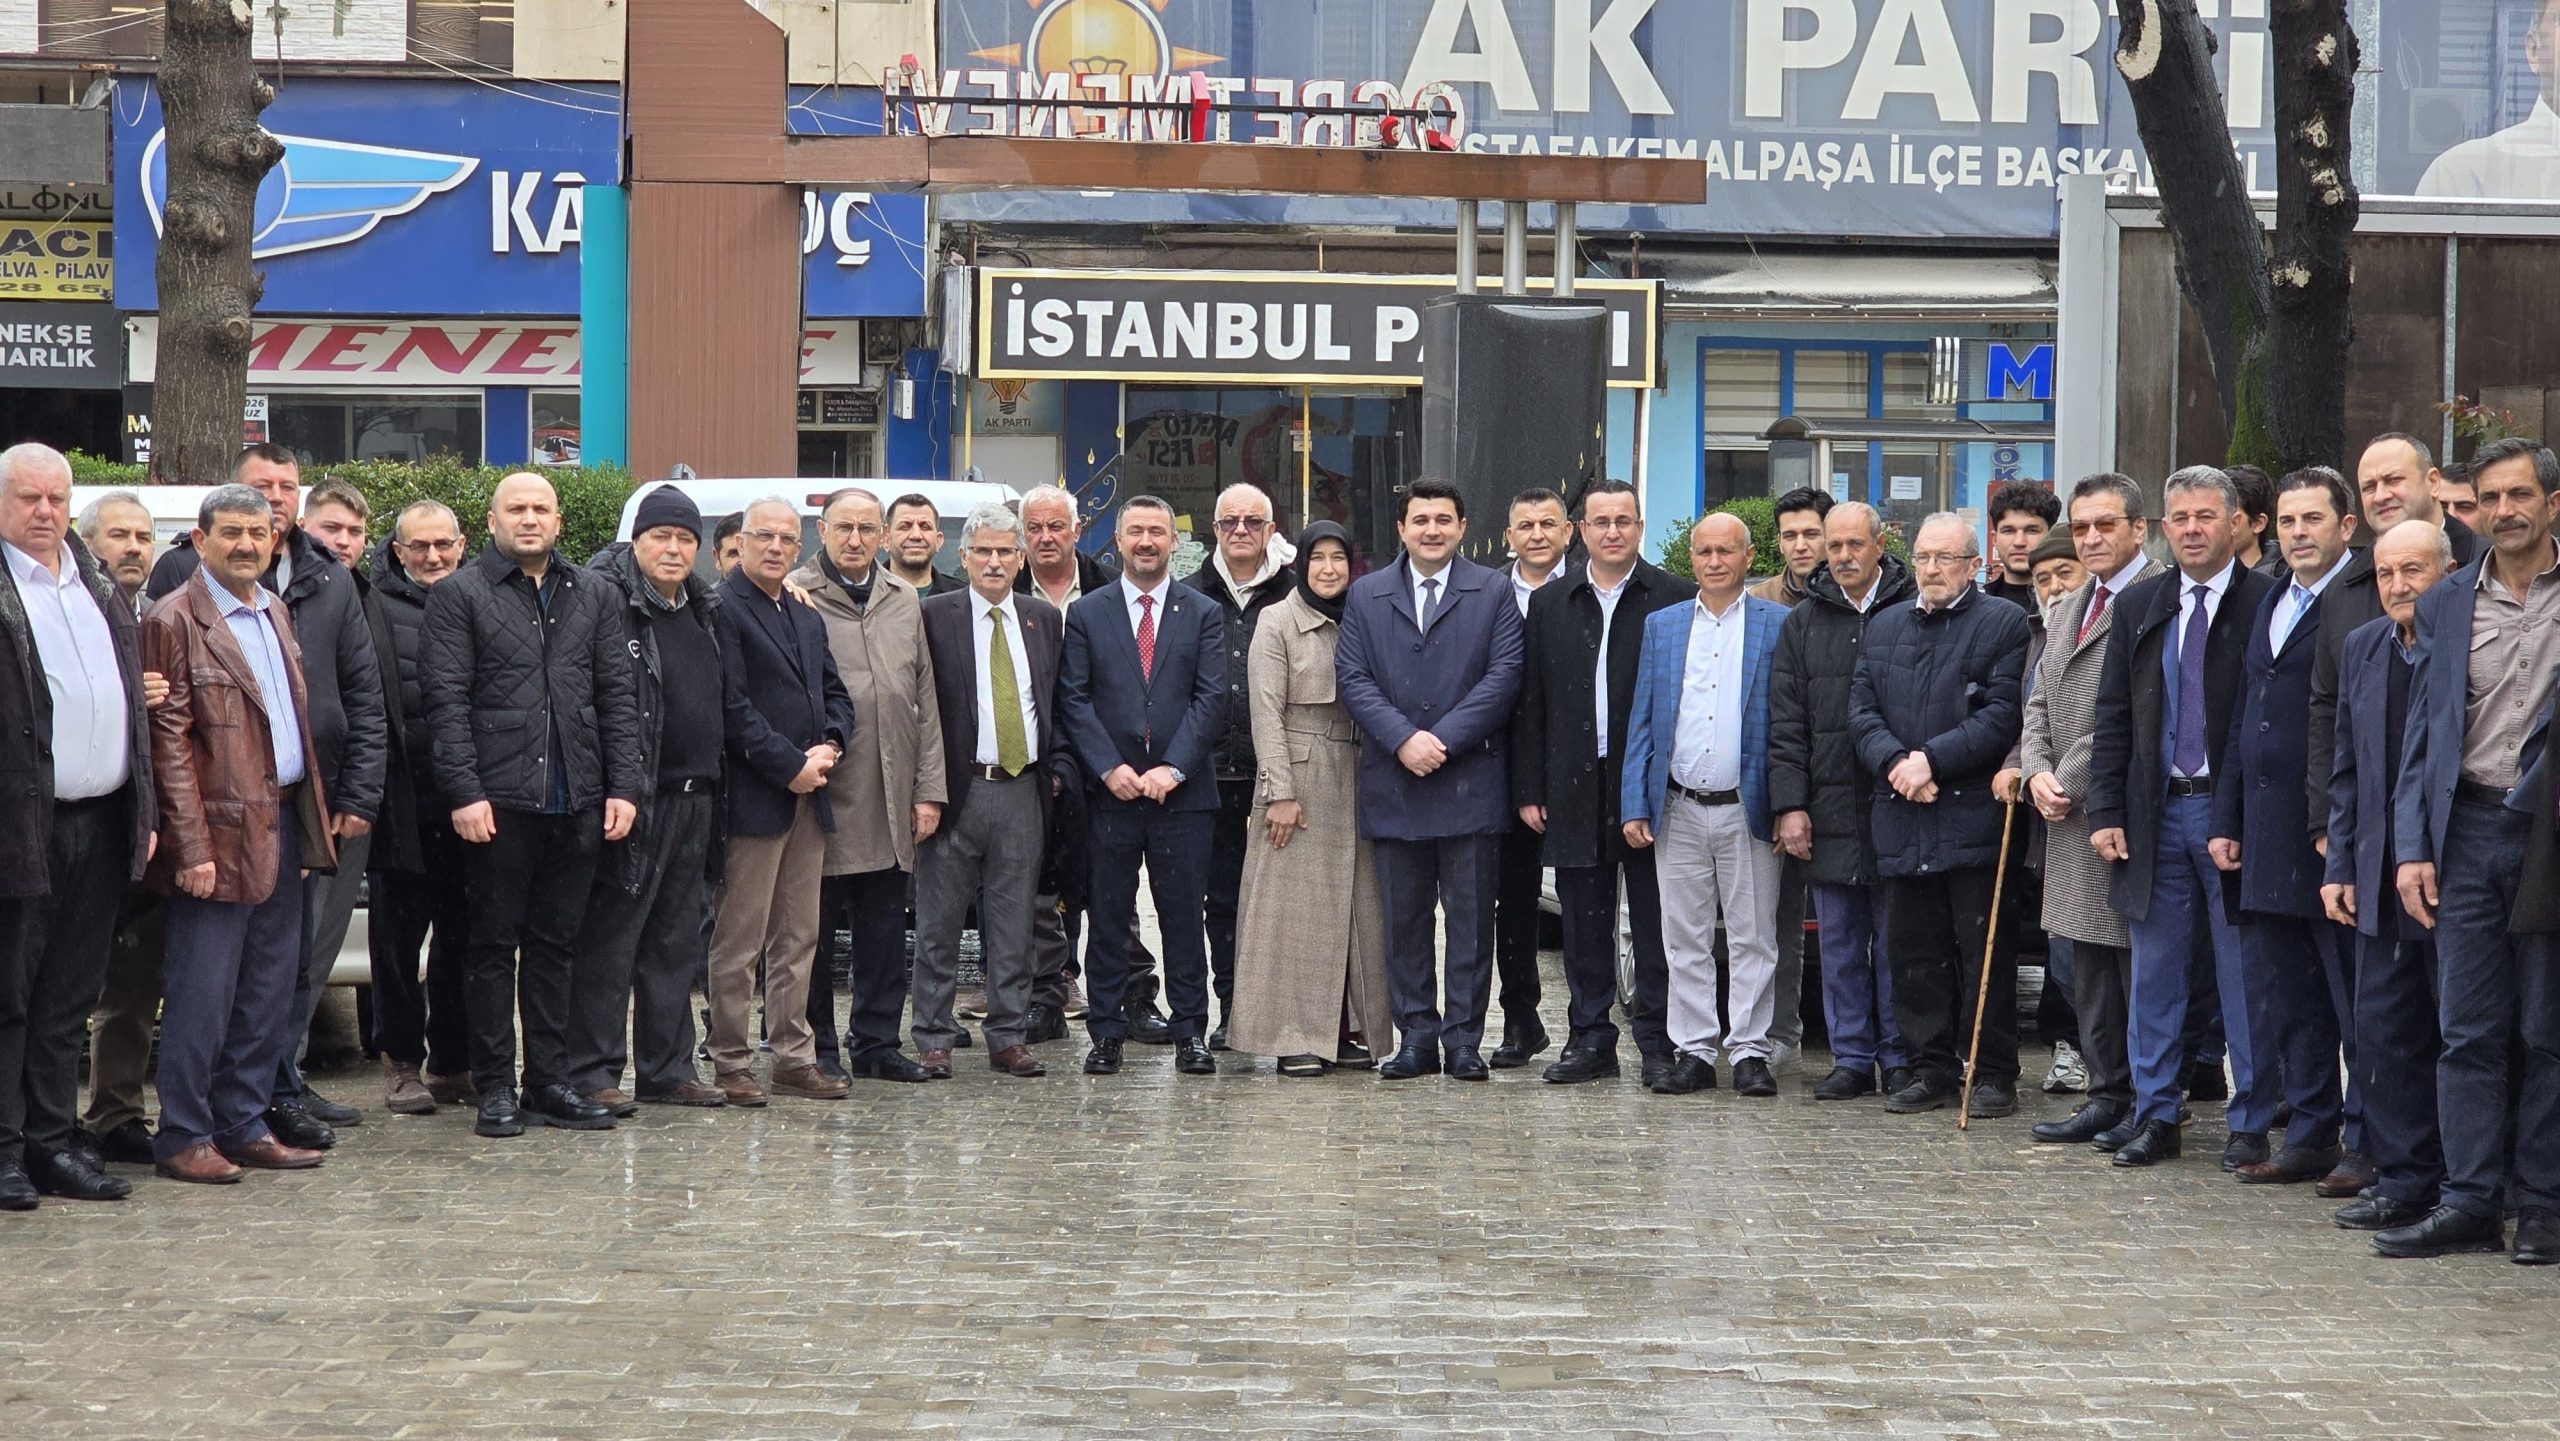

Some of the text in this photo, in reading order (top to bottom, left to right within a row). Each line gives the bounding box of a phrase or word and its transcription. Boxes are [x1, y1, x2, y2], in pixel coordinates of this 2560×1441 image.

[1395, 0, 1674, 115] AK
[1889, 133, 1983, 194] İLÇE
[1006, 282, 1350, 361] İSTANBUL
[0, 347, 96, 368] ARLIK
